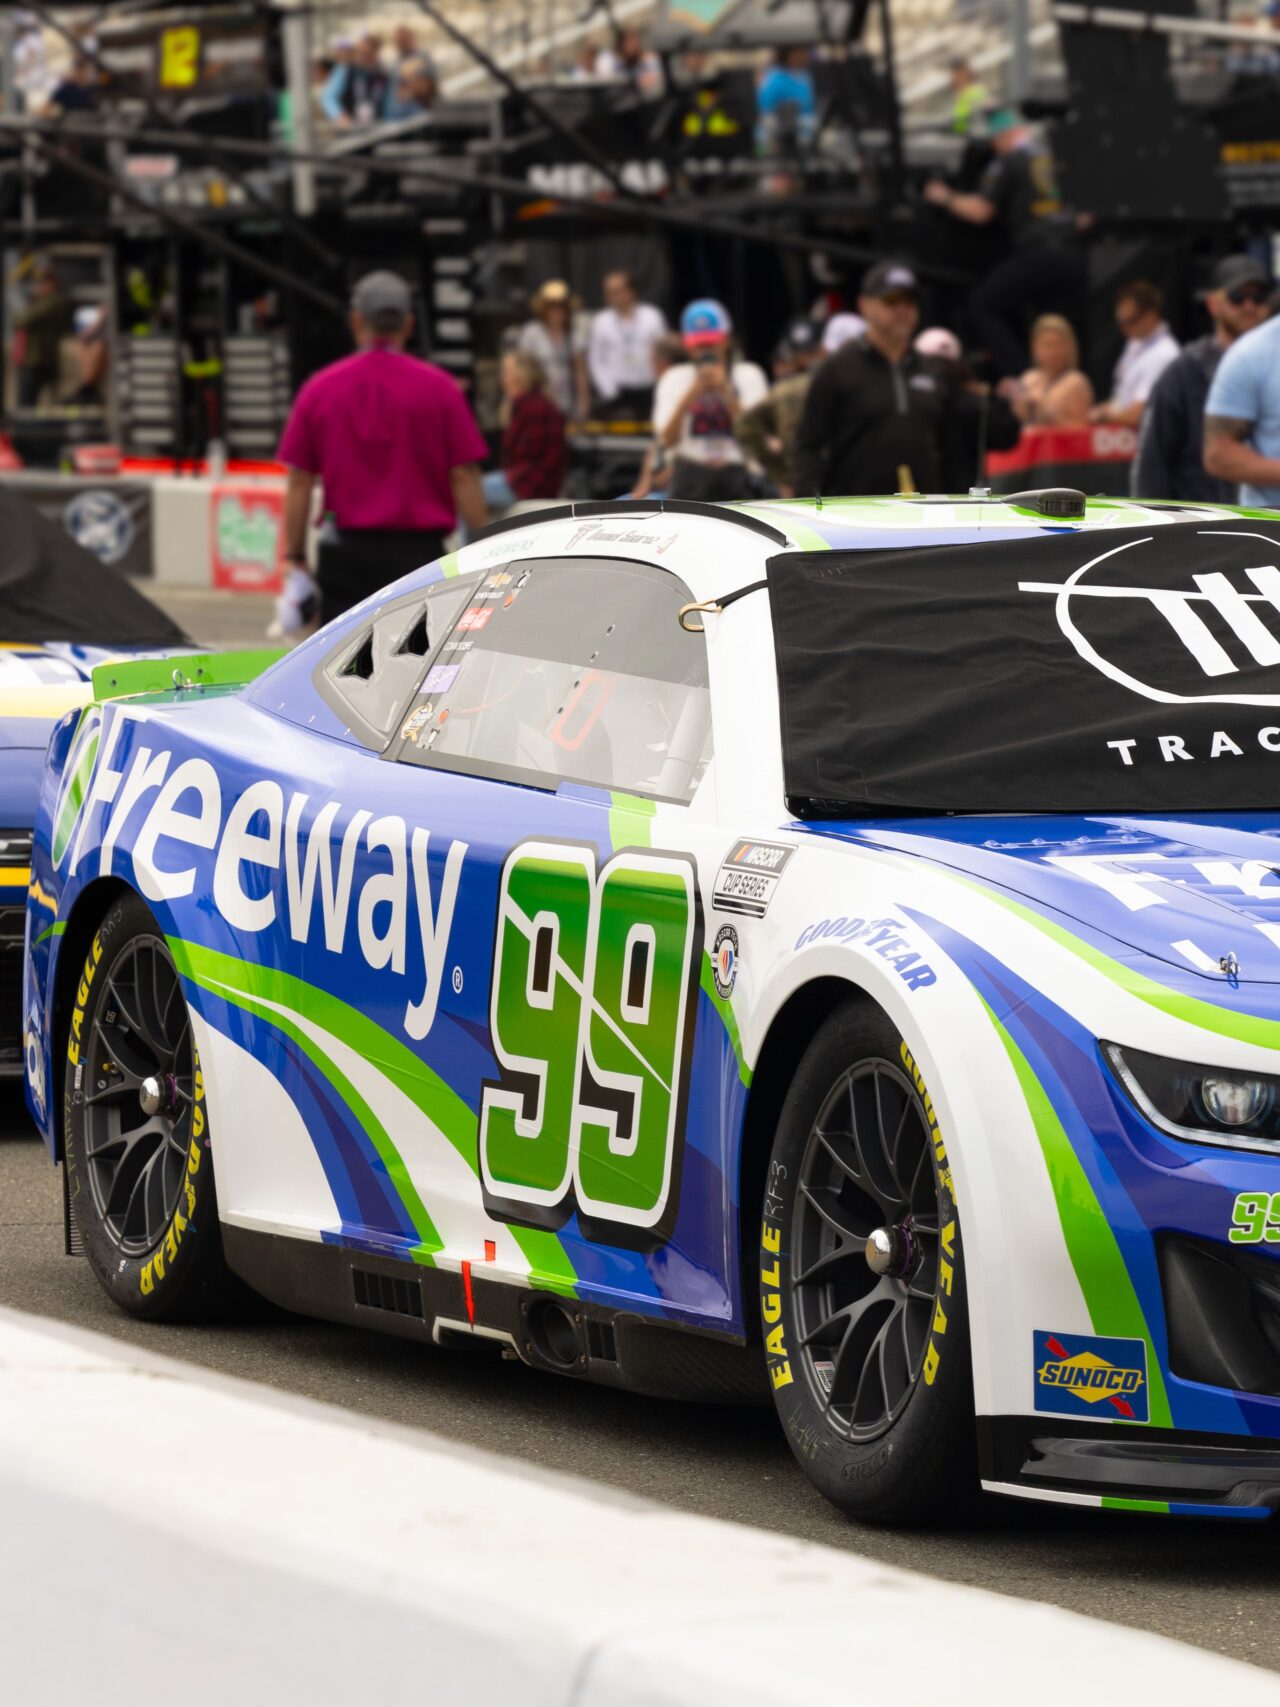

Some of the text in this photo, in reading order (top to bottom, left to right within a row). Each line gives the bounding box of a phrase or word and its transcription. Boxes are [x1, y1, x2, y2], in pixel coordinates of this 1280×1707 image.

[69, 704, 469, 1041] Freeway
[722, 872, 770, 898] CUP SERIES
[744, 845, 786, 869] NASCAR
[67, 929, 104, 1067] EAGLE
[794, 916, 938, 992] GOODYEAR
[478, 836, 704, 1243] 99
[140, 1040, 206, 1296] OODYEAR
[761, 1220, 794, 1391] EAGLE
[1041, 1363, 1140, 1392] SUNOCO
